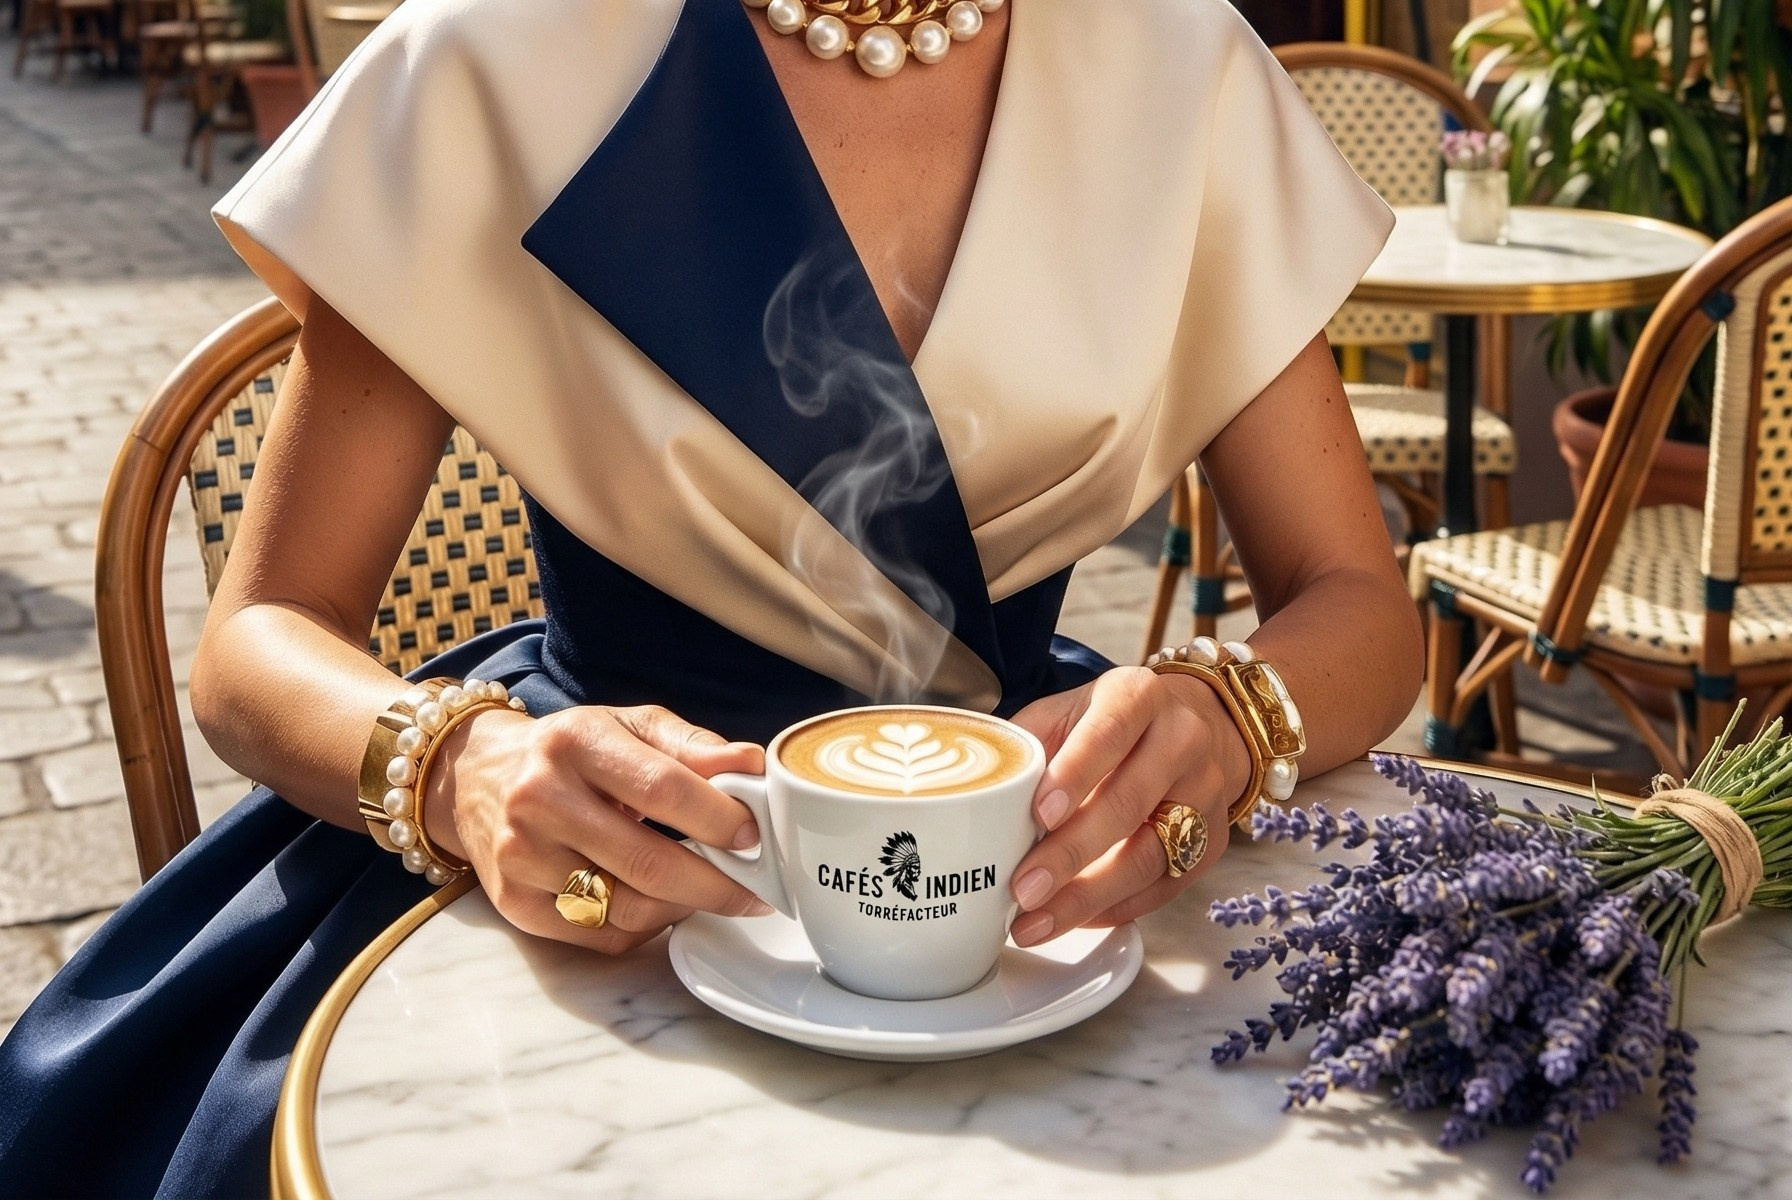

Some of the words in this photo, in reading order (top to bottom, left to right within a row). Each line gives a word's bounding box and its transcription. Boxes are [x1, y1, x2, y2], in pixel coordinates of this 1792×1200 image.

[818, 864, 883, 898] CAFÉS
[926, 865, 996, 899] INDIEN
[858, 902, 957, 921] TORRÉFACTEUR
